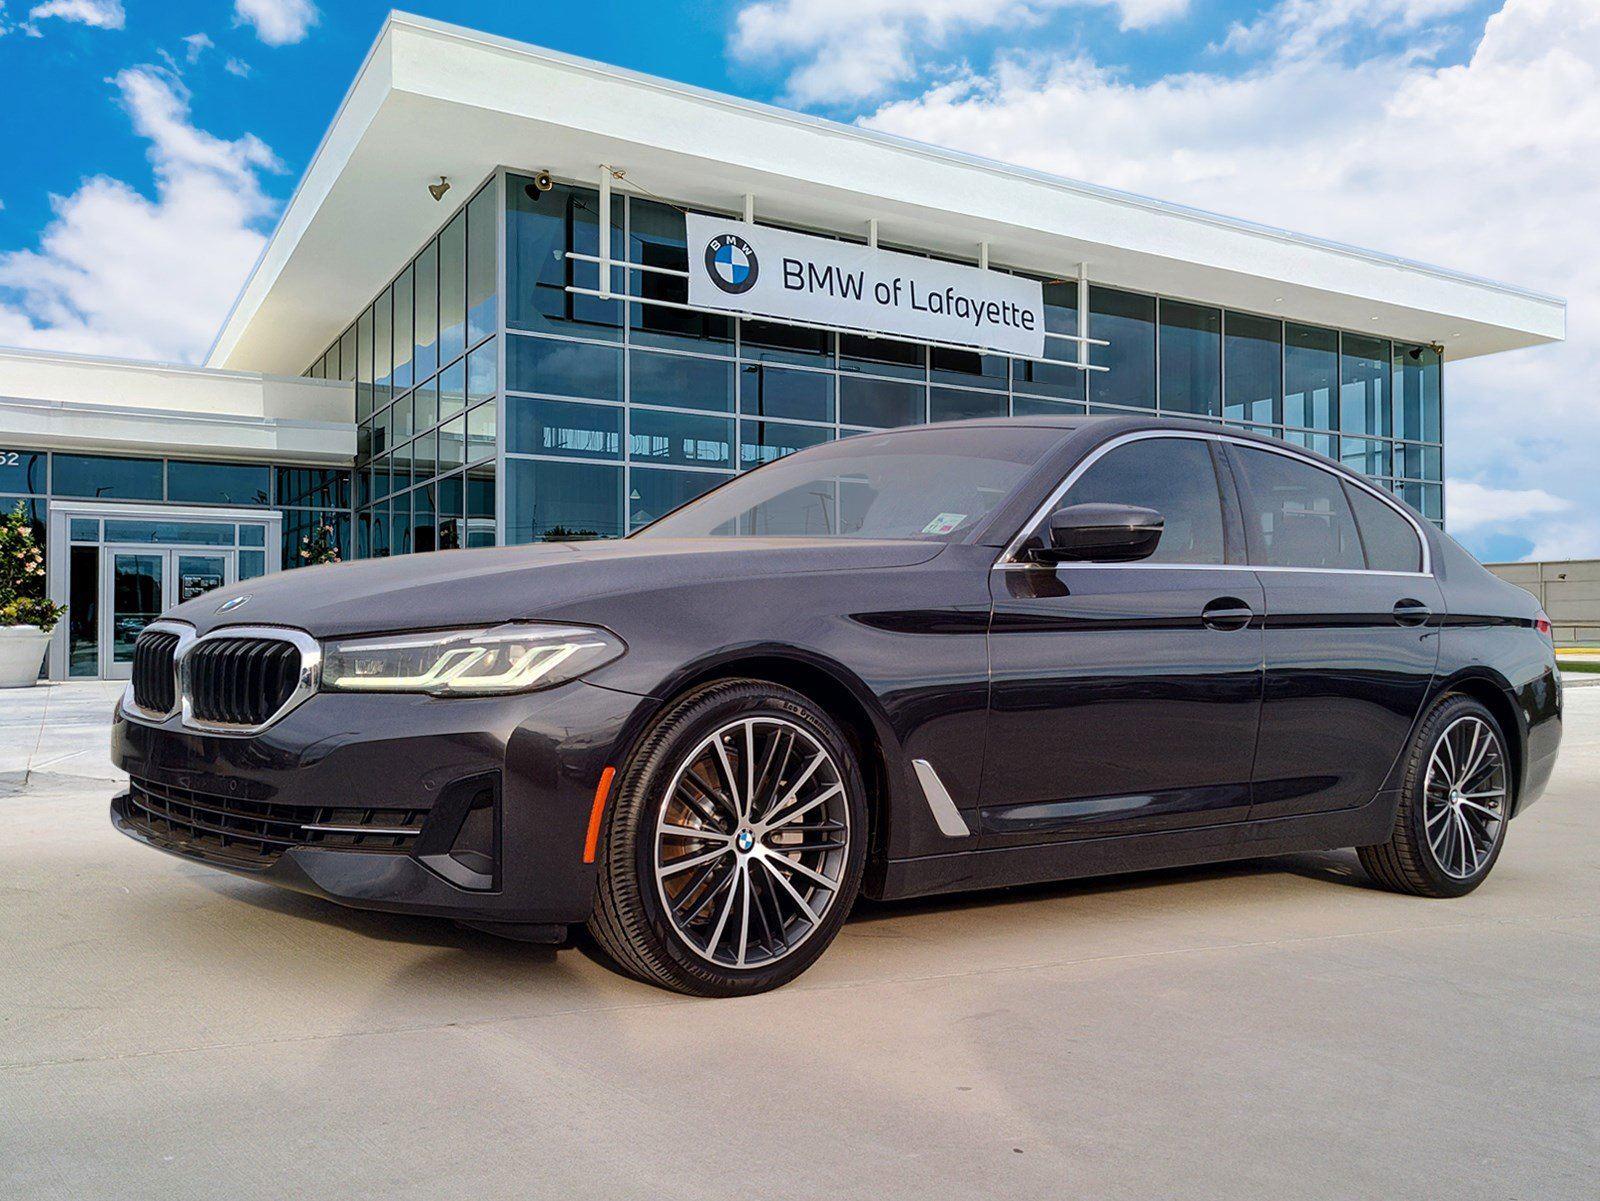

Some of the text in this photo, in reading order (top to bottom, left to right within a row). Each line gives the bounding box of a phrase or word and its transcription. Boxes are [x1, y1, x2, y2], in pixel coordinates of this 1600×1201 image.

[710, 235, 752, 255] BMW
[783, 258, 1035, 331] BMW of Lafayette
